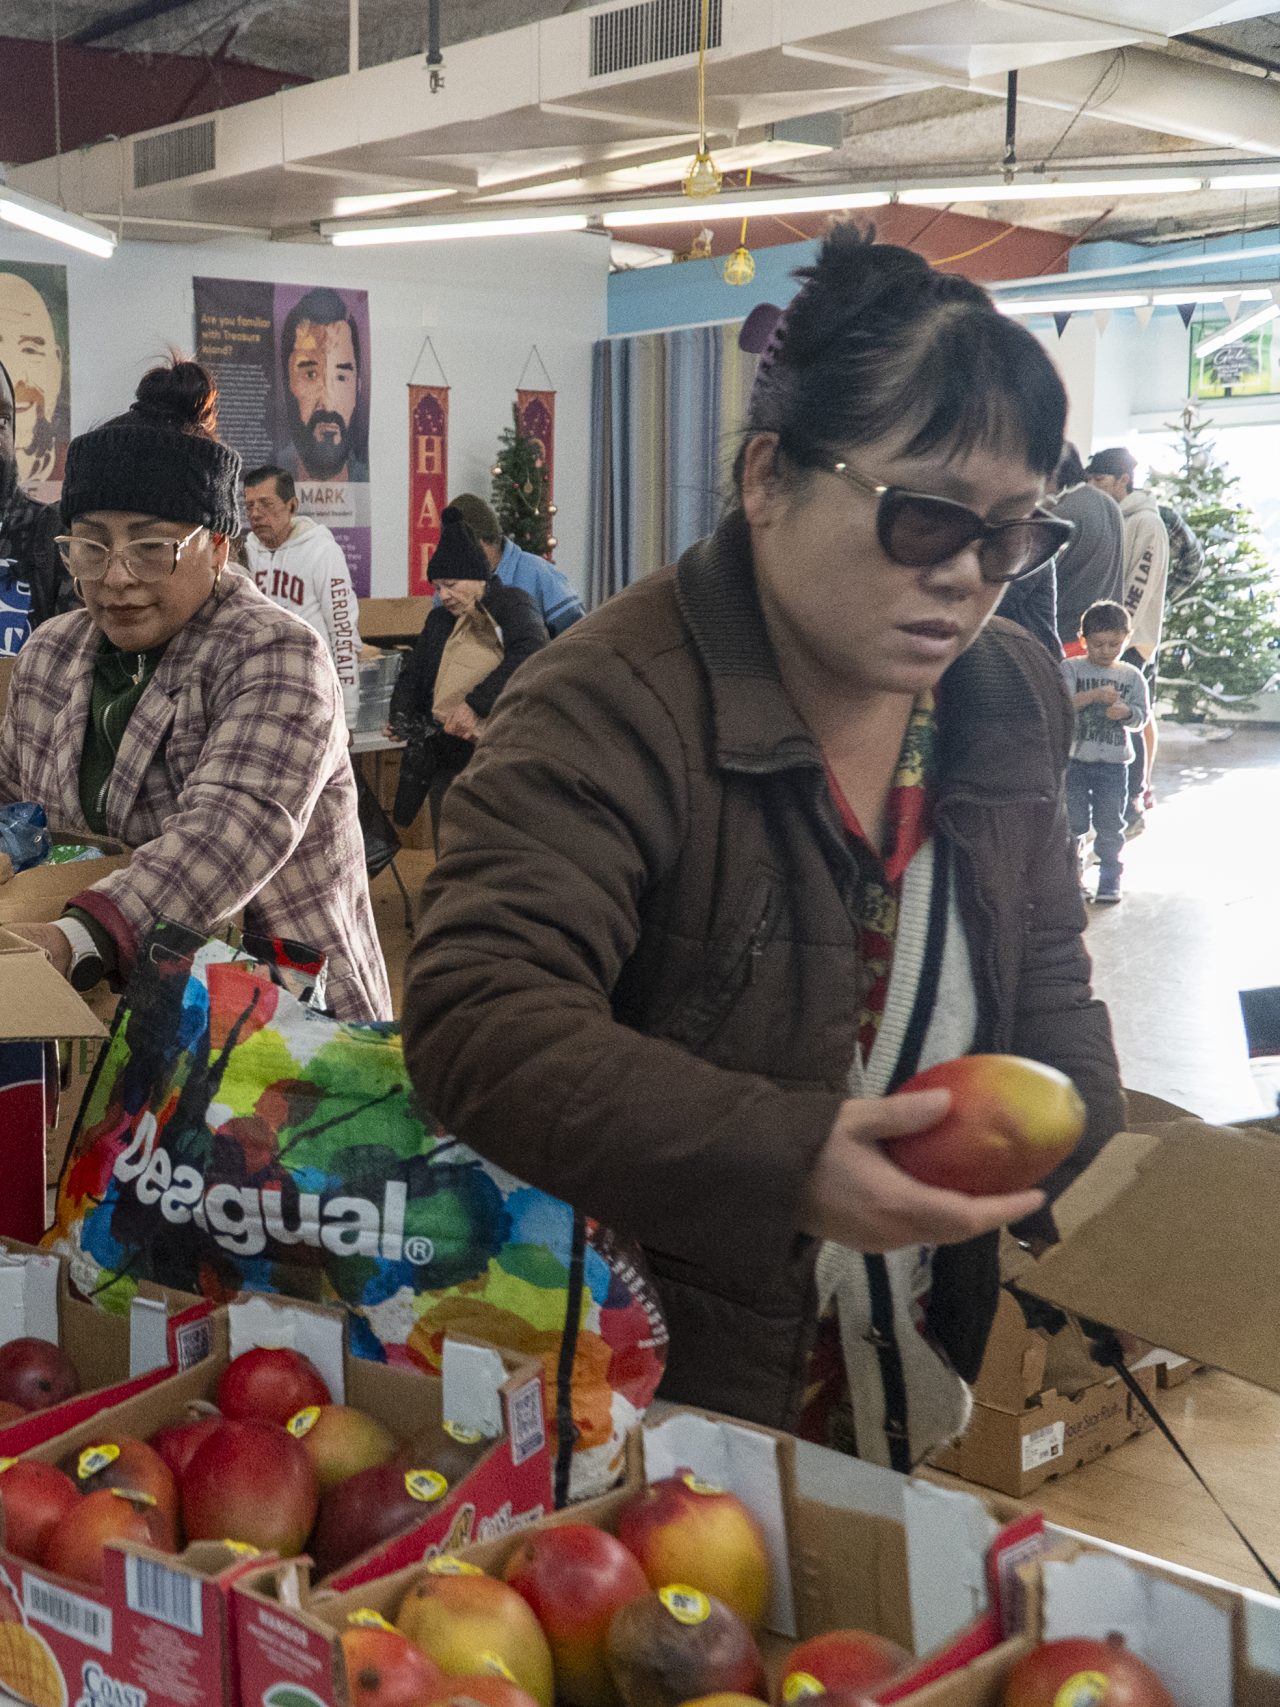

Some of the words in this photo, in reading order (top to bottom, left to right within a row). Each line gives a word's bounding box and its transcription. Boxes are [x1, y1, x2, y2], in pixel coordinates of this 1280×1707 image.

[201, 314, 217, 324] Are
[220, 318, 235, 328] you
[238, 315, 271, 328] familiar
[202, 330, 220, 338] with
[224, 330, 261, 341] Treasure
[301, 488, 345, 504] MARK
